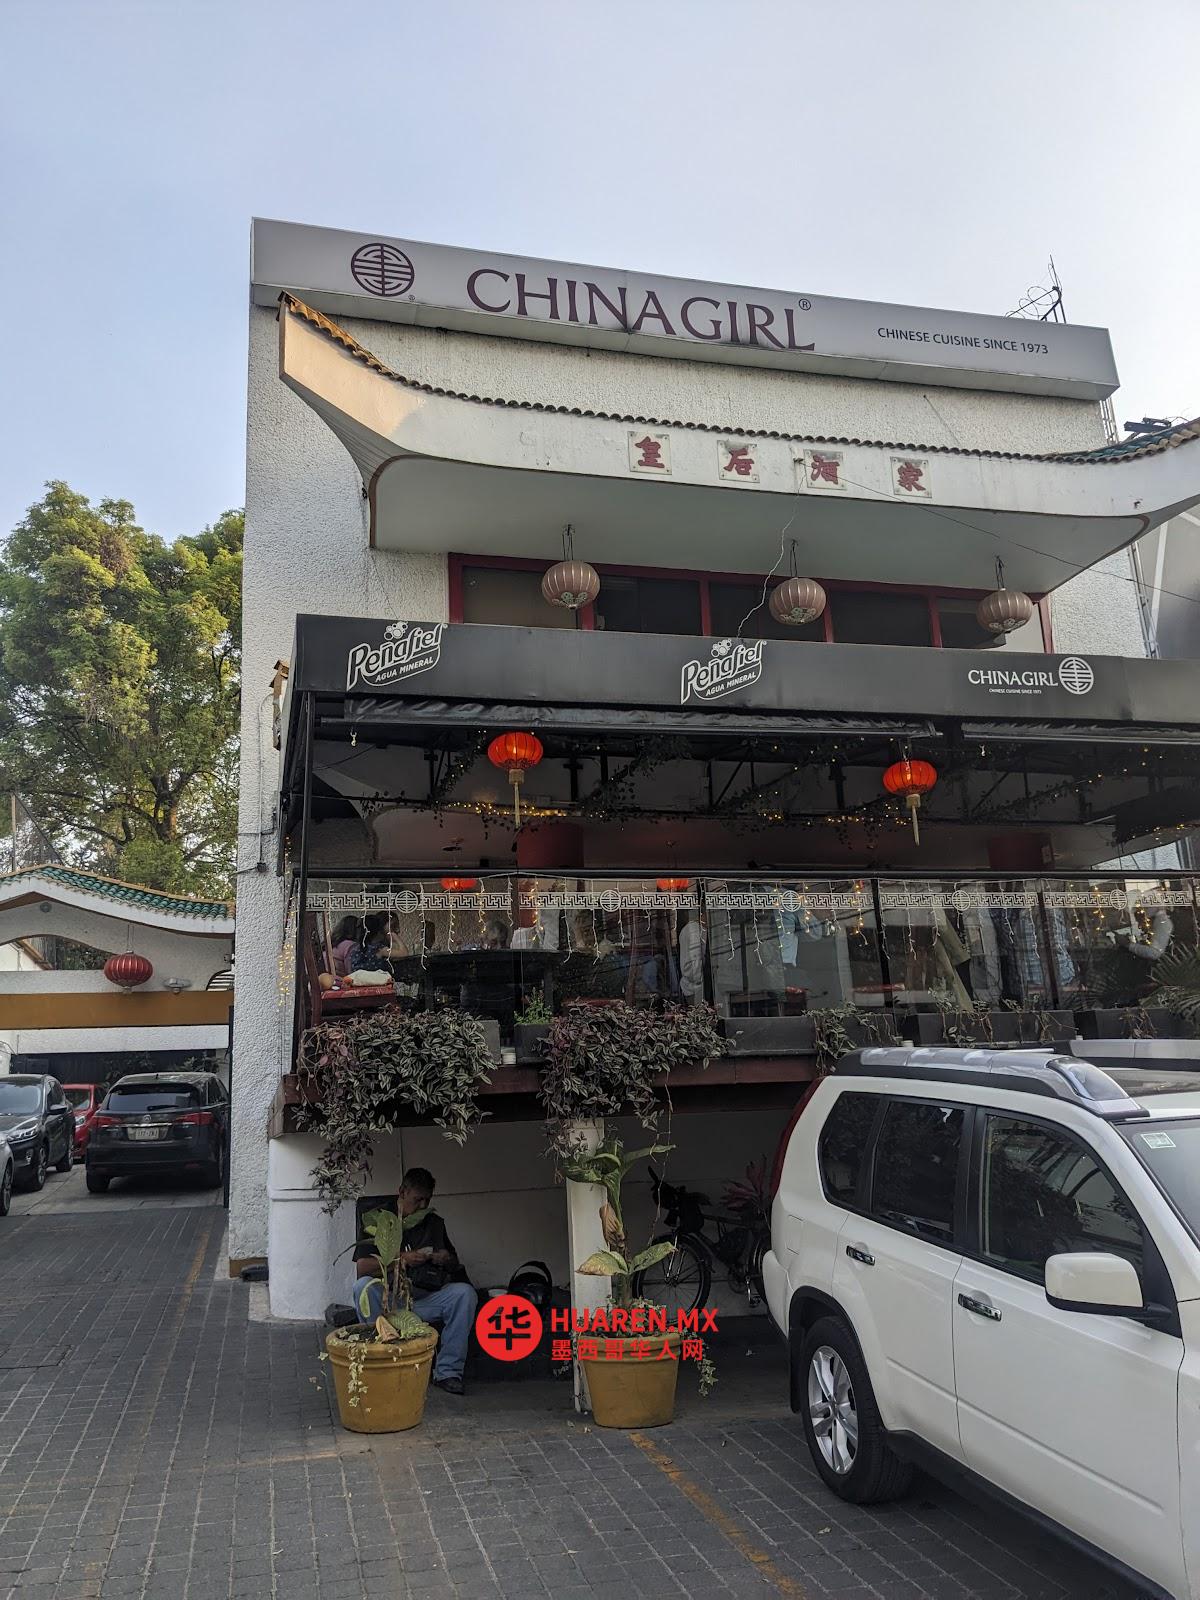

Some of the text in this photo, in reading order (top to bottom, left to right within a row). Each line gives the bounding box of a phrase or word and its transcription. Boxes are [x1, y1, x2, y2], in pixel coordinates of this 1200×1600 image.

[877, 327, 1049, 354] CHINESE CUISINE SINCE 1973
[375, 656, 434, 683] AGUA MINERAL
[967, 669, 1059, 686] CHINAGIRL
[705, 671, 757, 696] AGUA MINERAL
